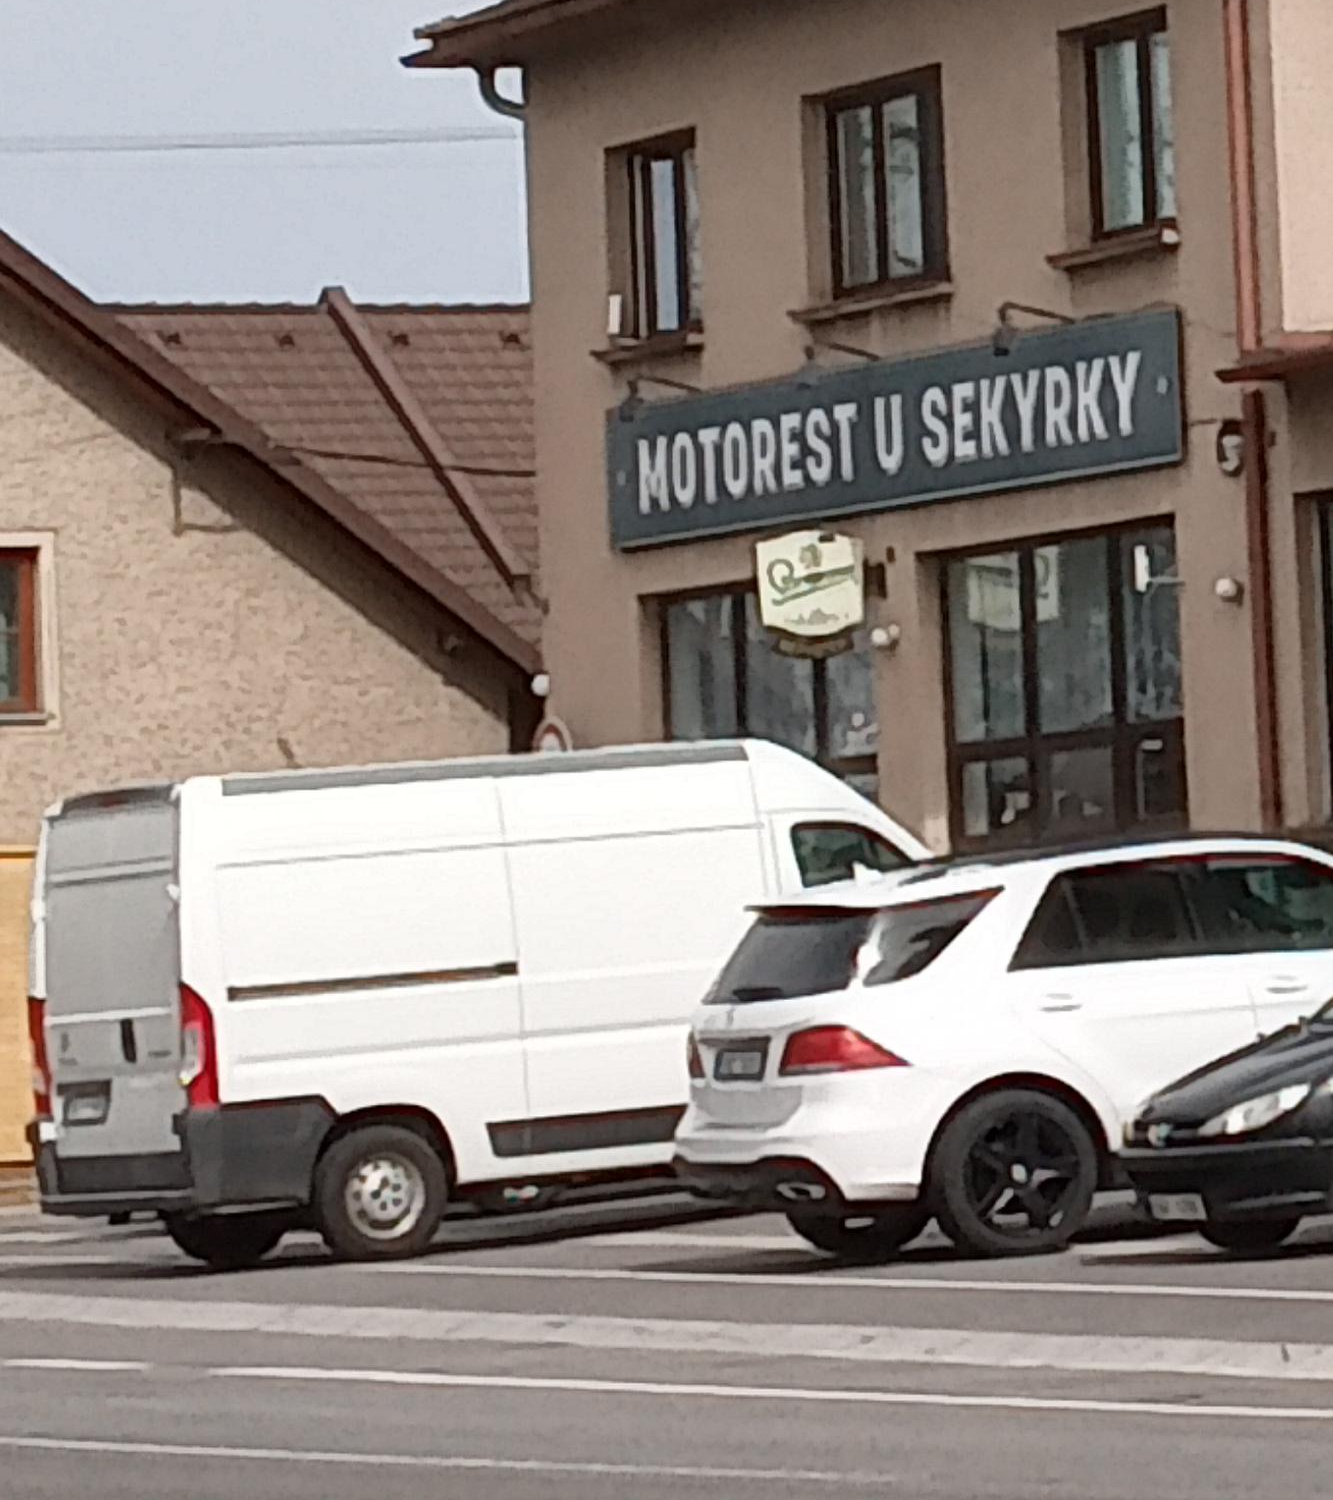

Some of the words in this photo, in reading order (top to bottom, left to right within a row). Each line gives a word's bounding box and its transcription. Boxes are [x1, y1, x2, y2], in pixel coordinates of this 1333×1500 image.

[637, 402, 857, 515] MOTOREST
[874, 394, 904, 476] U
[921, 350, 1142, 468] SEKYRKY
